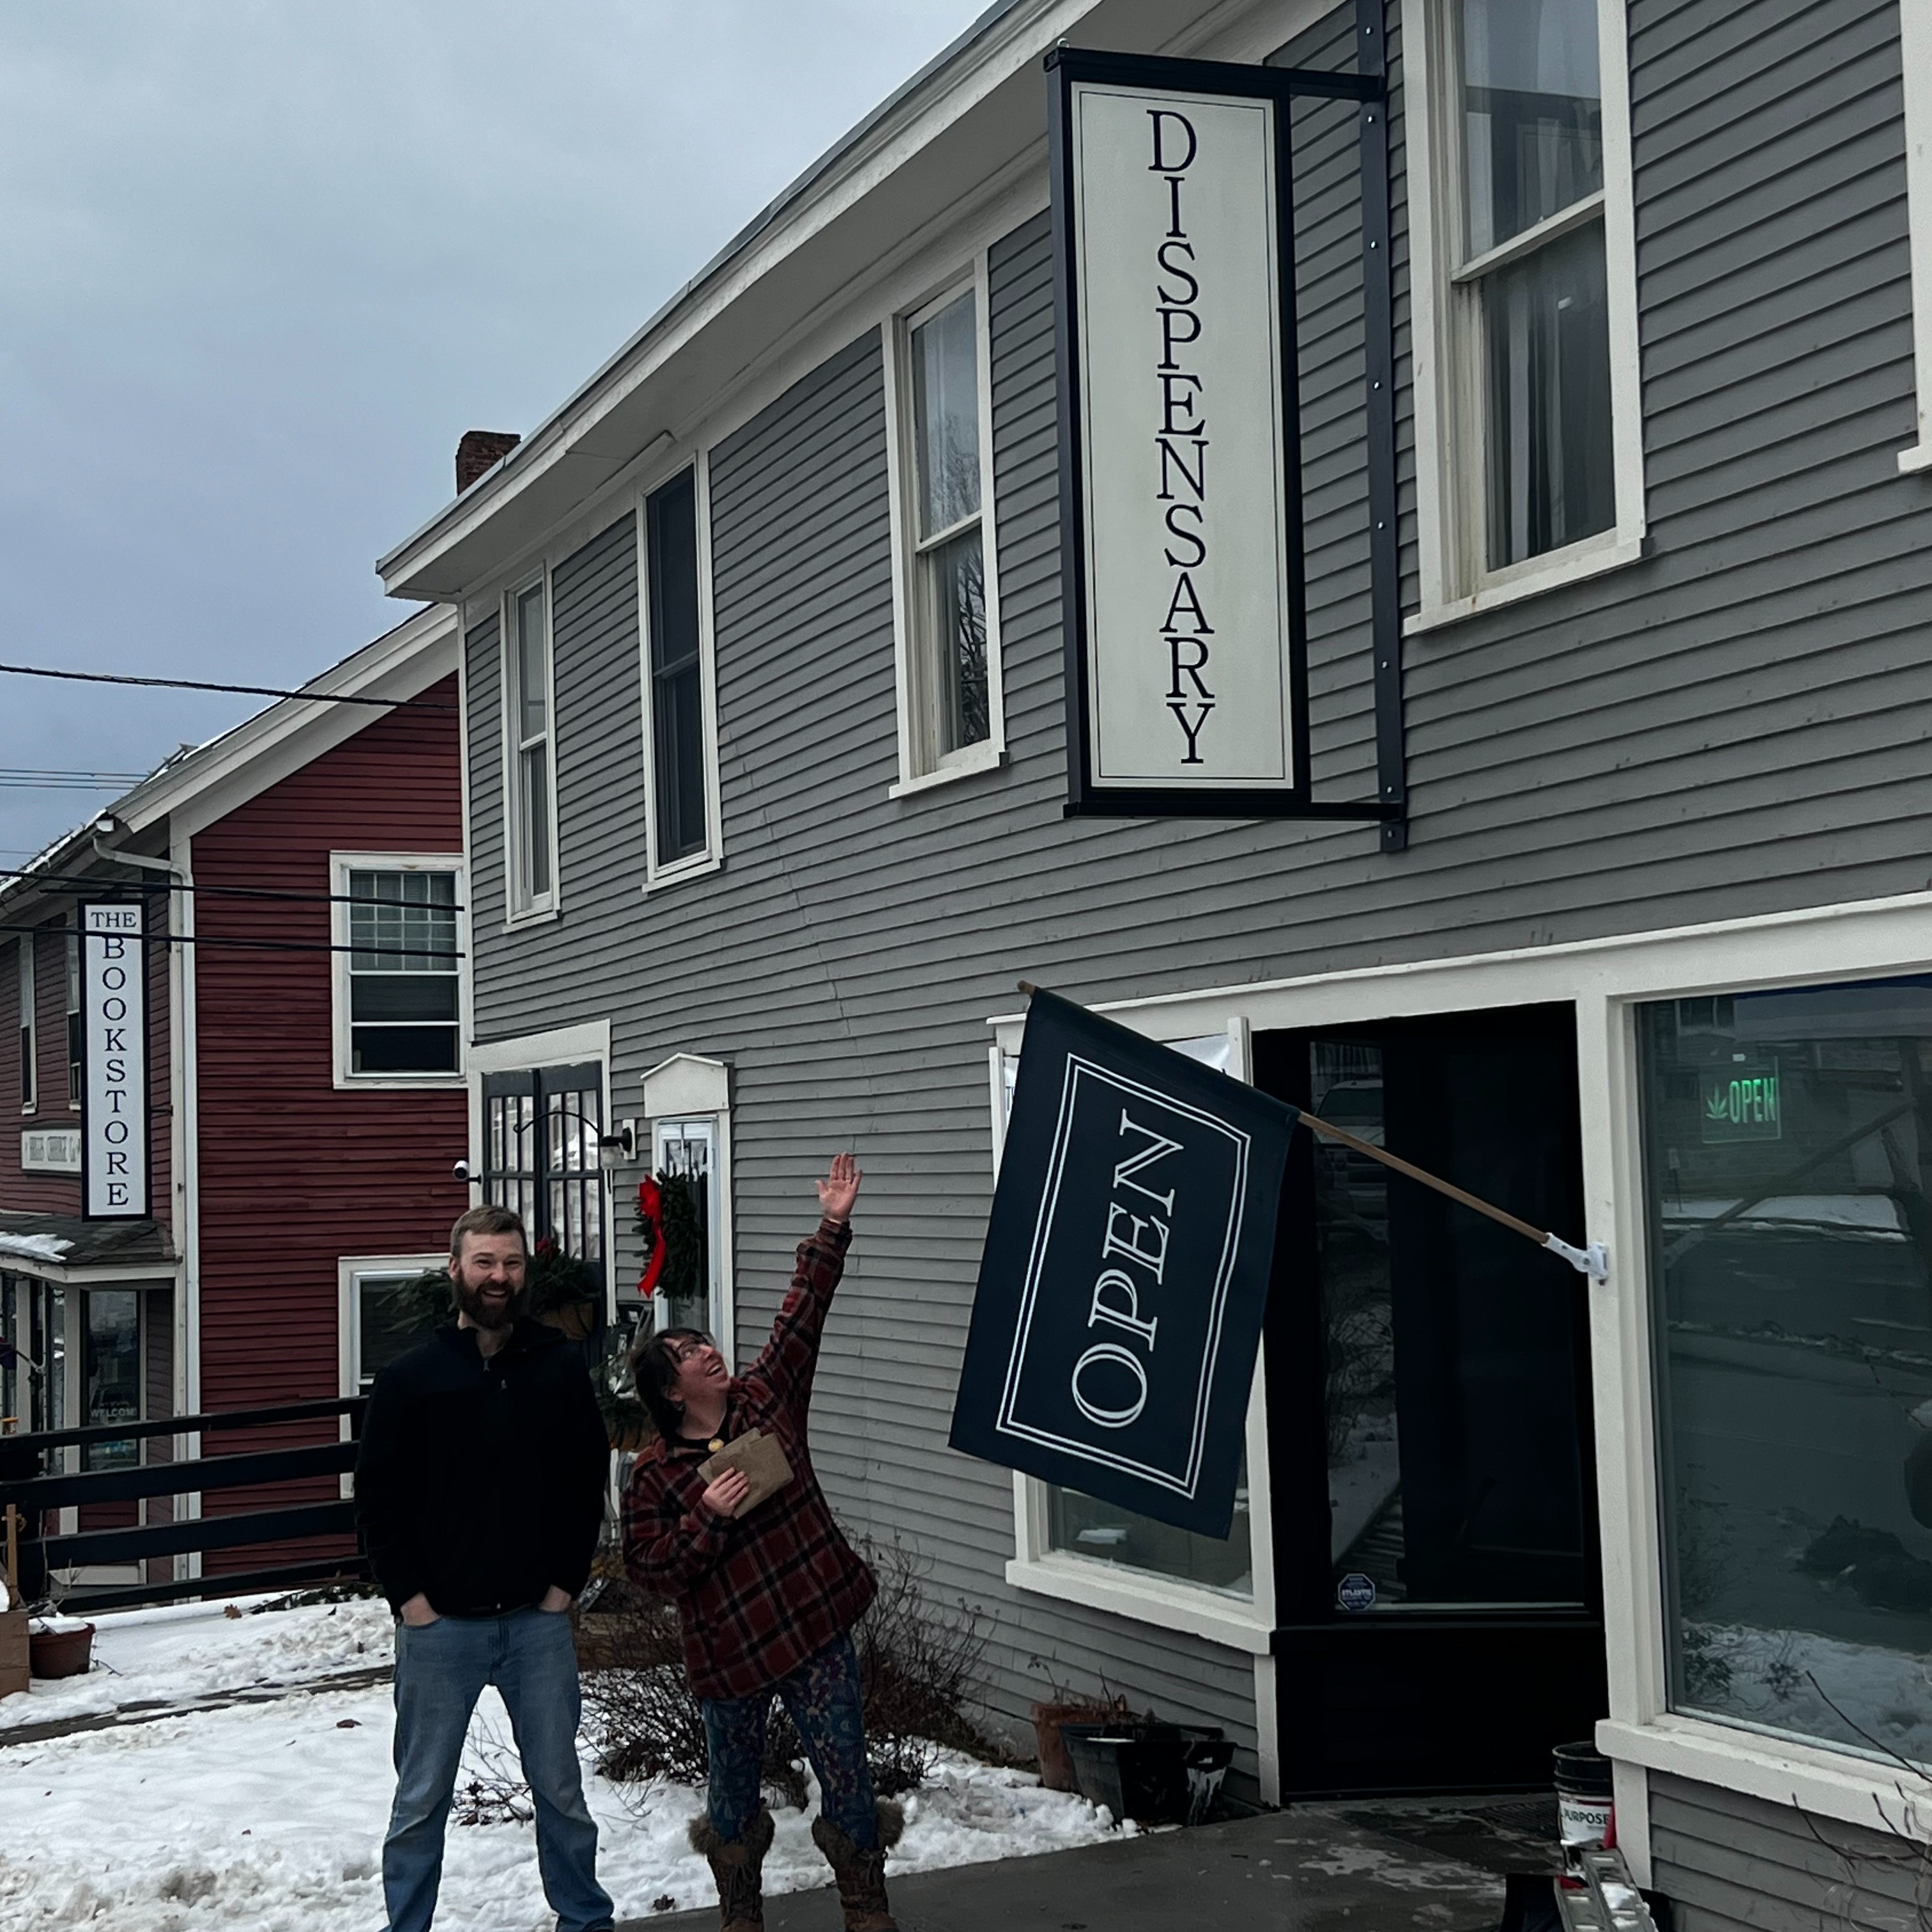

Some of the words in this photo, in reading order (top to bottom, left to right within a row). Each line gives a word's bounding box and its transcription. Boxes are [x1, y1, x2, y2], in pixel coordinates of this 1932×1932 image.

[1146, 109, 1215, 765] DISPENSARY
[90, 912, 137, 928] THE
[102, 935, 129, 1206] BOOKSTORE
[1729, 1077, 1775, 1124] OPEN
[1071, 1108, 1184, 1429] OPEN
